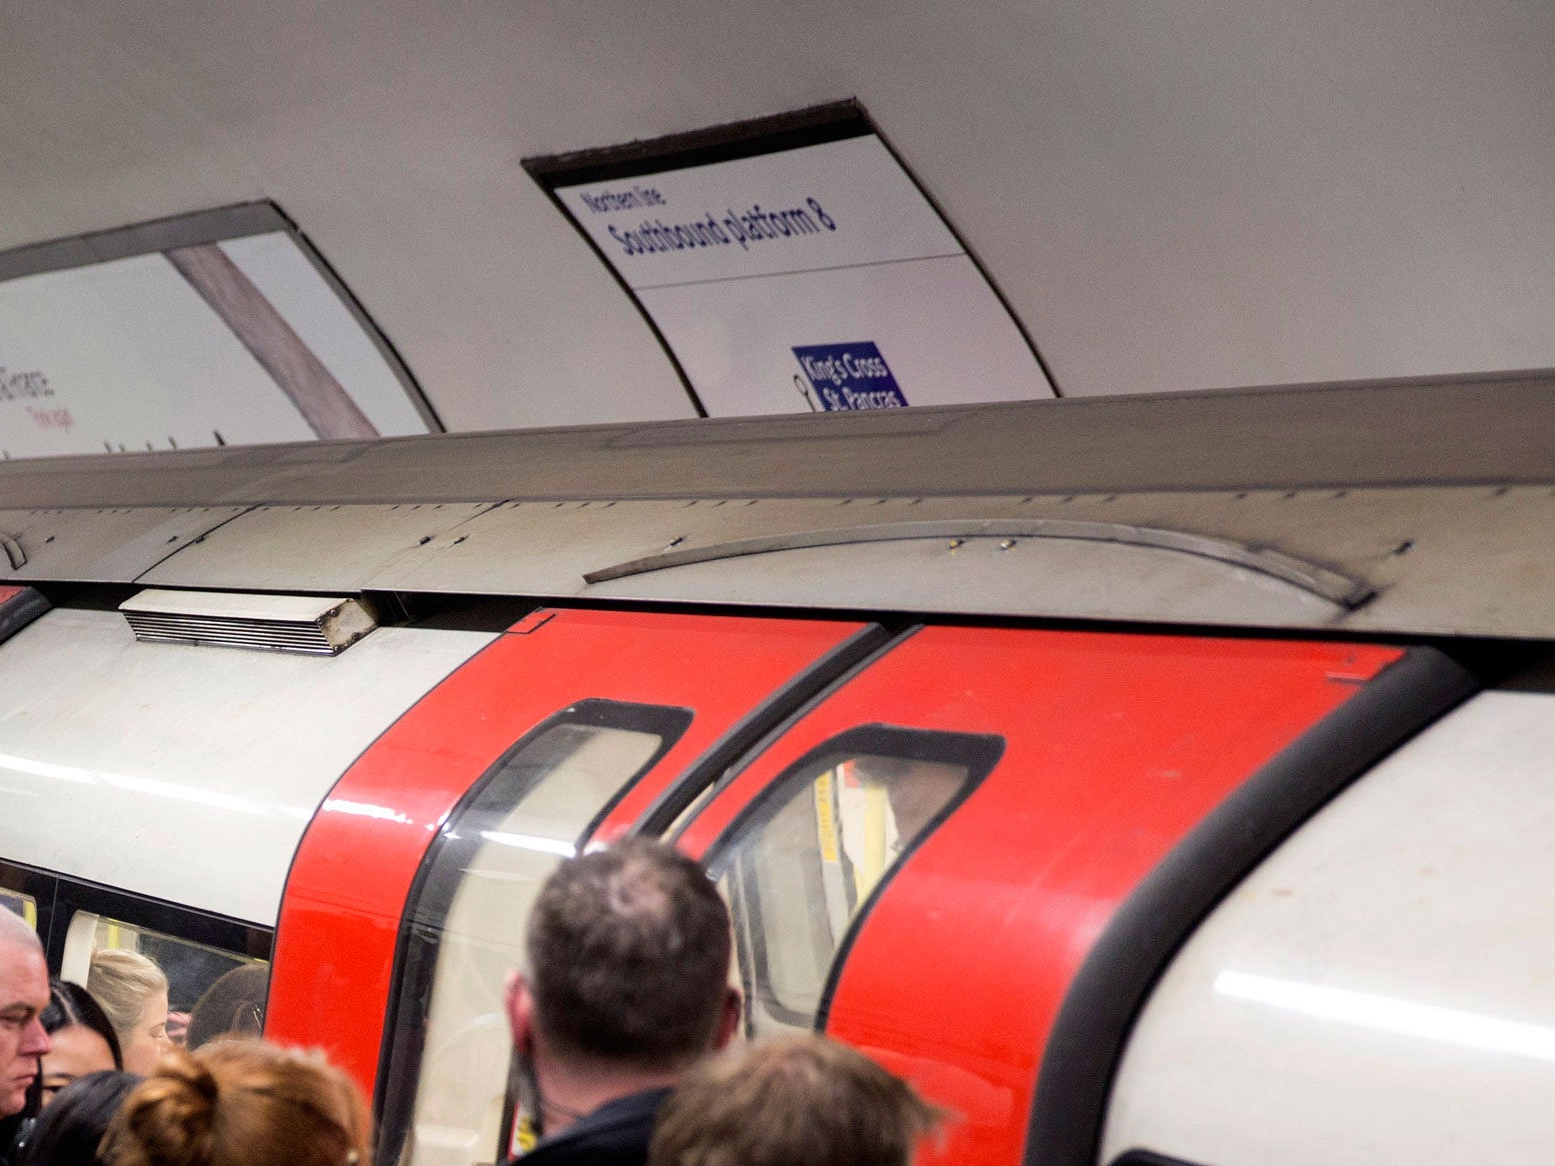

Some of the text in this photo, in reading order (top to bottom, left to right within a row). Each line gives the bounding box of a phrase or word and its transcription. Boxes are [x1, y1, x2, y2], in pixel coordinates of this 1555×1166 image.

[608, 196, 837, 256] Southbound platform 8
[801, 352, 888, 385] King's Cross
[842, 386, 902, 411] Pancras
